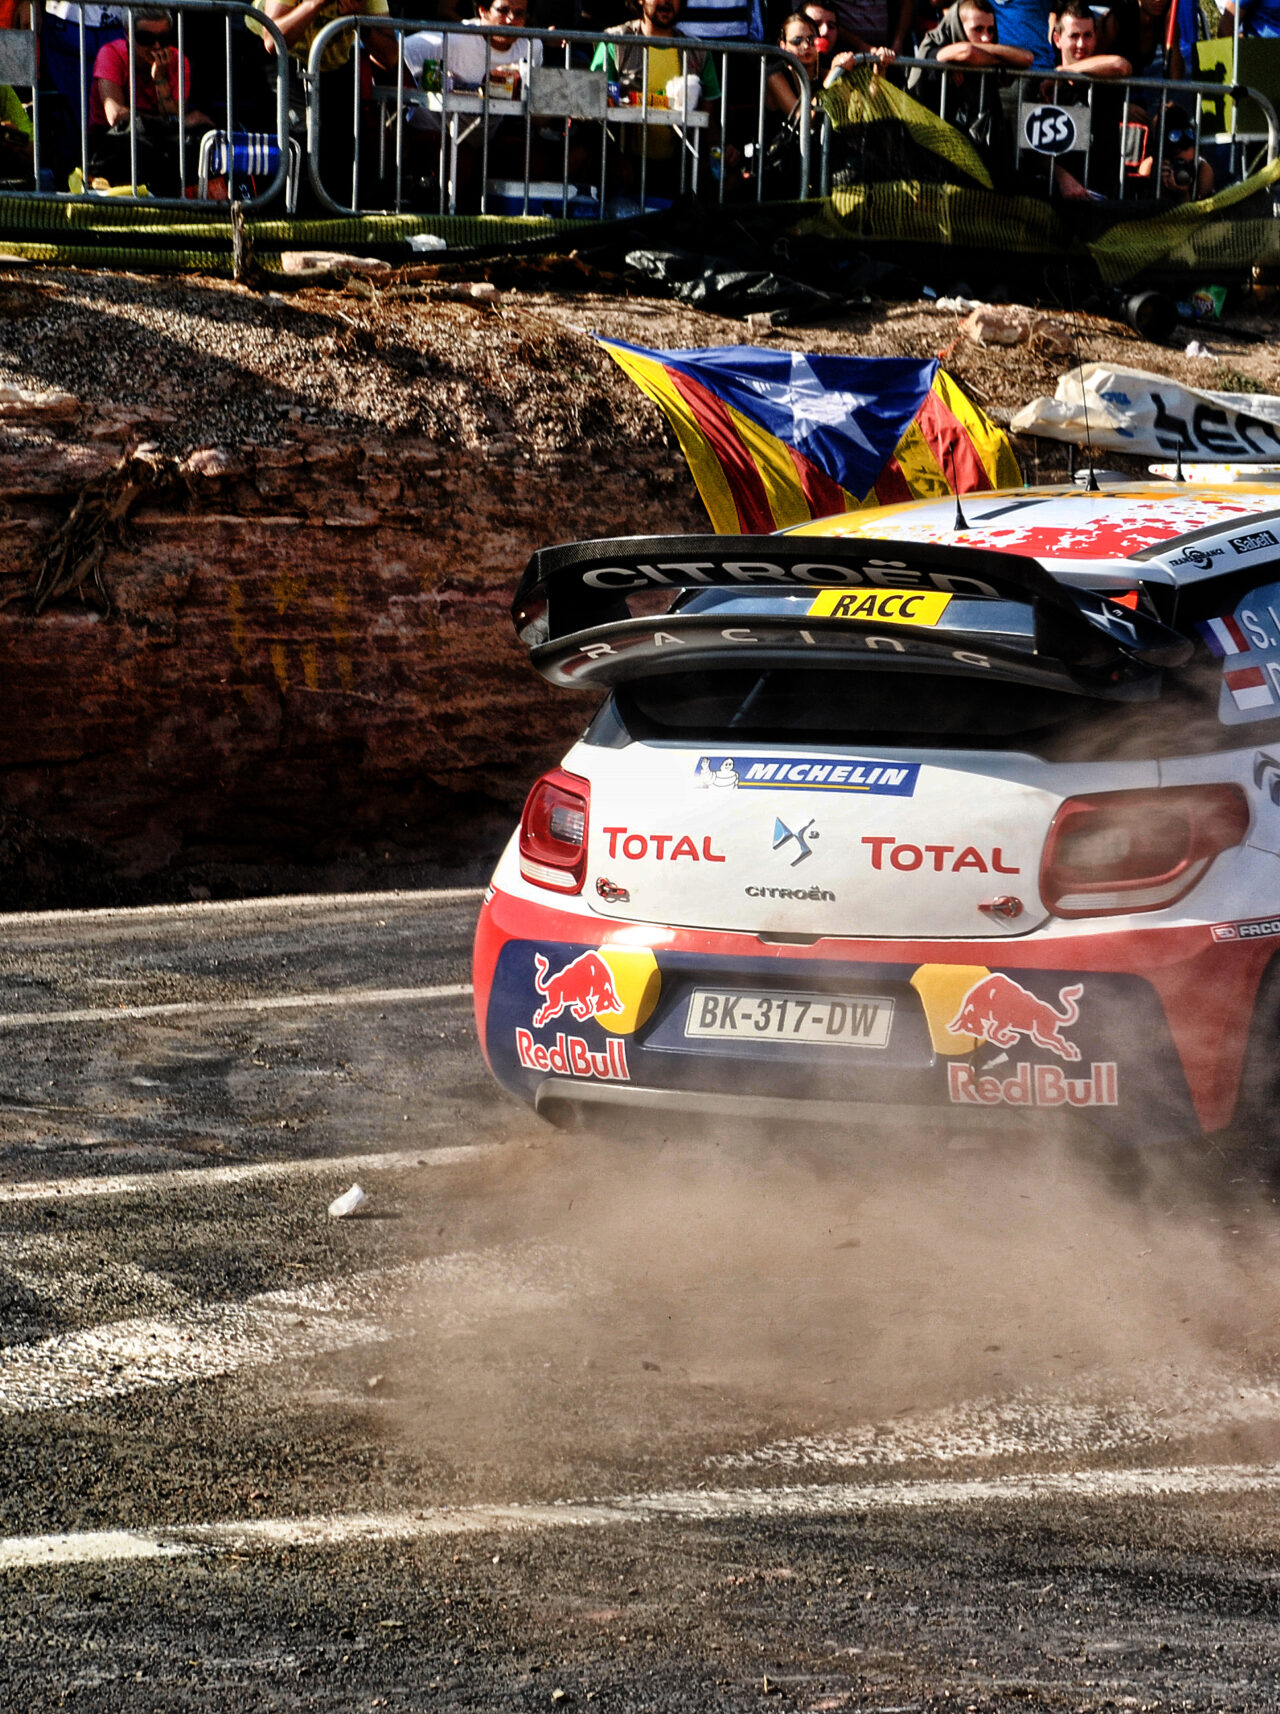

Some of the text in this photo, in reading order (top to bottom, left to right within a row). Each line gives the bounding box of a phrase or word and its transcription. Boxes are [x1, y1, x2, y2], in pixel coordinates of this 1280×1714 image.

[1233, 531, 1275, 552] Sabelt
[582, 559, 1000, 597] CITROËN
[829, 594, 926, 618] RACC
[580, 628, 991, 668] RACING
[1241, 609, 1277, 649] S.
[746, 763, 908, 787] MICHELIN
[603, 827, 1021, 874] TOTAL TOTAL
[699, 996, 880, 1039] BK-317-DW
